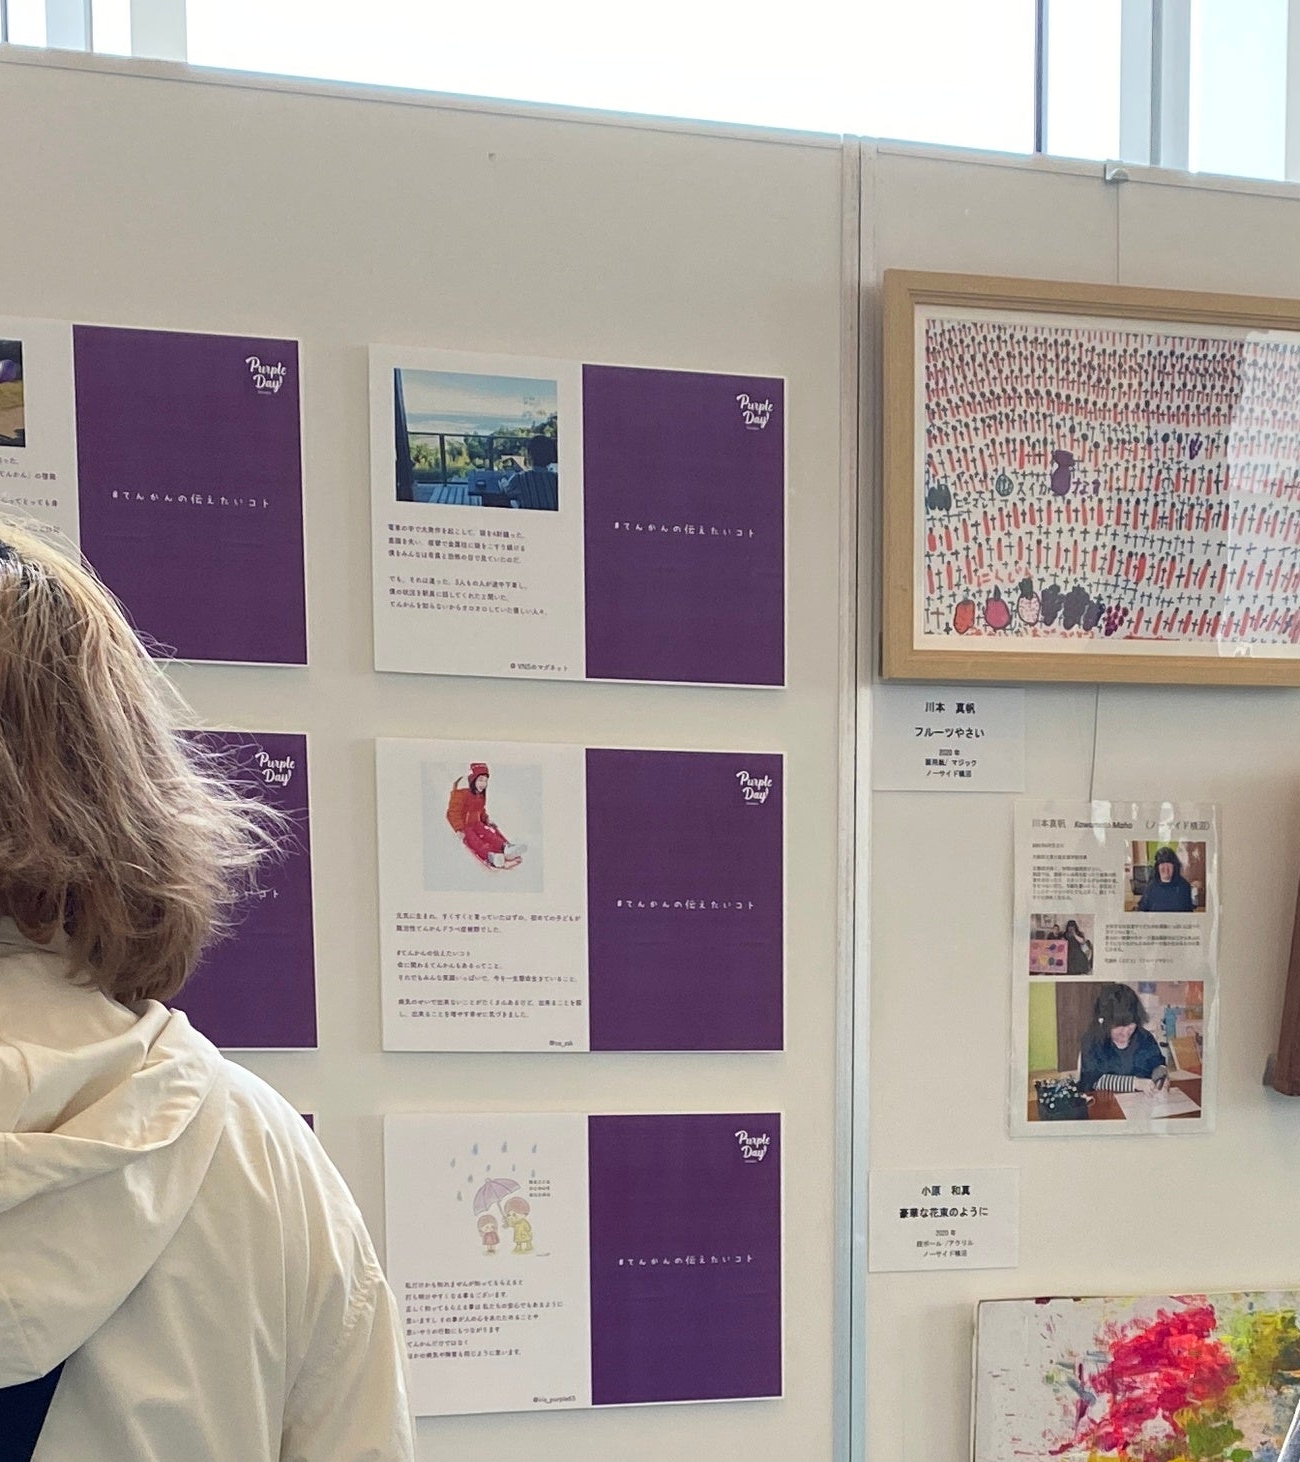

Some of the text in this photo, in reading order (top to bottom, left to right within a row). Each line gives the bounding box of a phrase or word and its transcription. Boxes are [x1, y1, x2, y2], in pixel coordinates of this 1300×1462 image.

[245, 356, 287, 377] Purple
[735, 393, 774, 413] Purple
[925, 702, 946, 713] 川本
[914, 727, 985, 739] フルーツやさい
[254, 751, 295, 772] Purple
[736, 770, 773, 790] Purple
[734, 1129, 771, 1148] Purple
[899, 1206, 989, 1219] 豪華な花束のように
